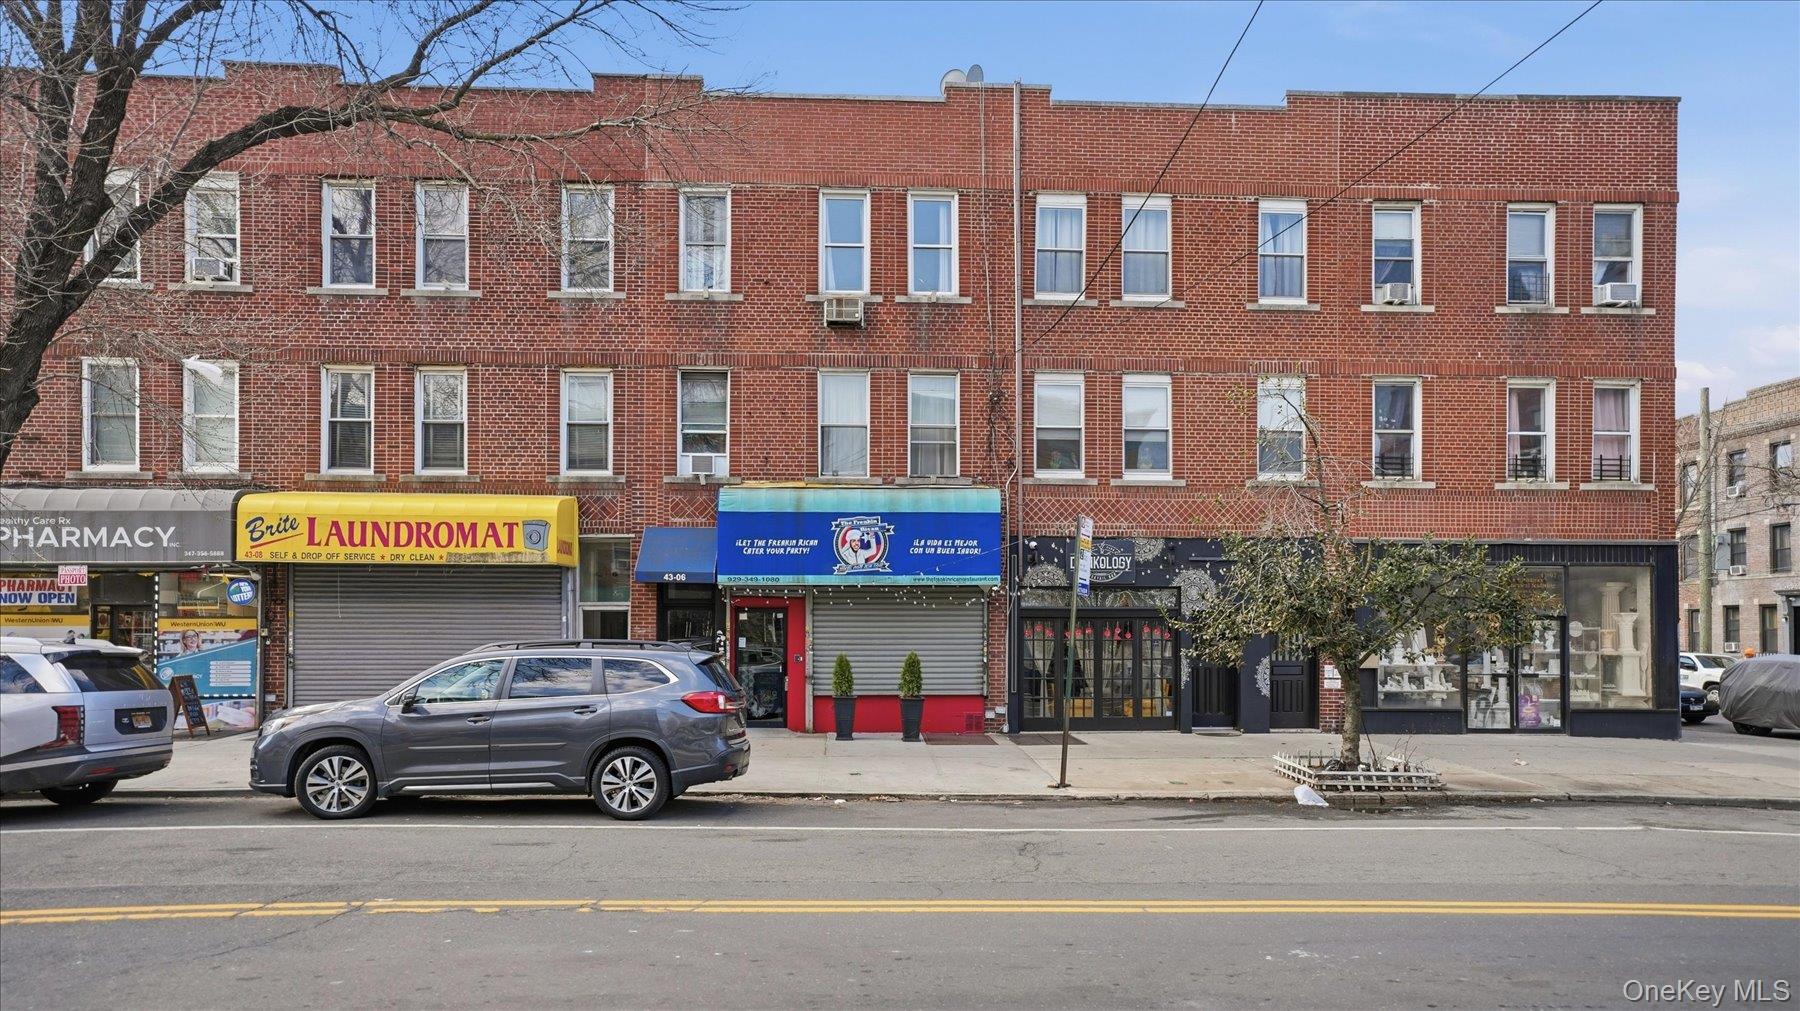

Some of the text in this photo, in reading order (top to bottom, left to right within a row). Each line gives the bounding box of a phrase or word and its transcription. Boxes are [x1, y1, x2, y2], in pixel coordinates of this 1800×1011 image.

[0, 516, 71, 526] ealthy Care Rx
[245, 515, 300, 542] Brite
[306, 517, 519, 549] LAUNDROMAT
[0, 526, 176, 548] PHARMACY
[768, 539, 797, 547] FREAKIN
[798, 539, 819, 547] RICAN
[944, 539, 953, 547] ES
[954, 539, 978, 547] MEJOR
[244, 551, 263, 559] 43-08
[301, 552, 323, 560] DROP
[326, 552, 340, 560] OFF
[344, 552, 376, 560] SERVICE
[742, 547, 810, 555] CATER YOUR PARTY!
[1070, 556, 1132, 570] DKOLOGY
[60, 574, 86, 584] PHOTO
[662, 573, 686, 581] 43-06
[0, 592, 75, 604] NOW OPEN
